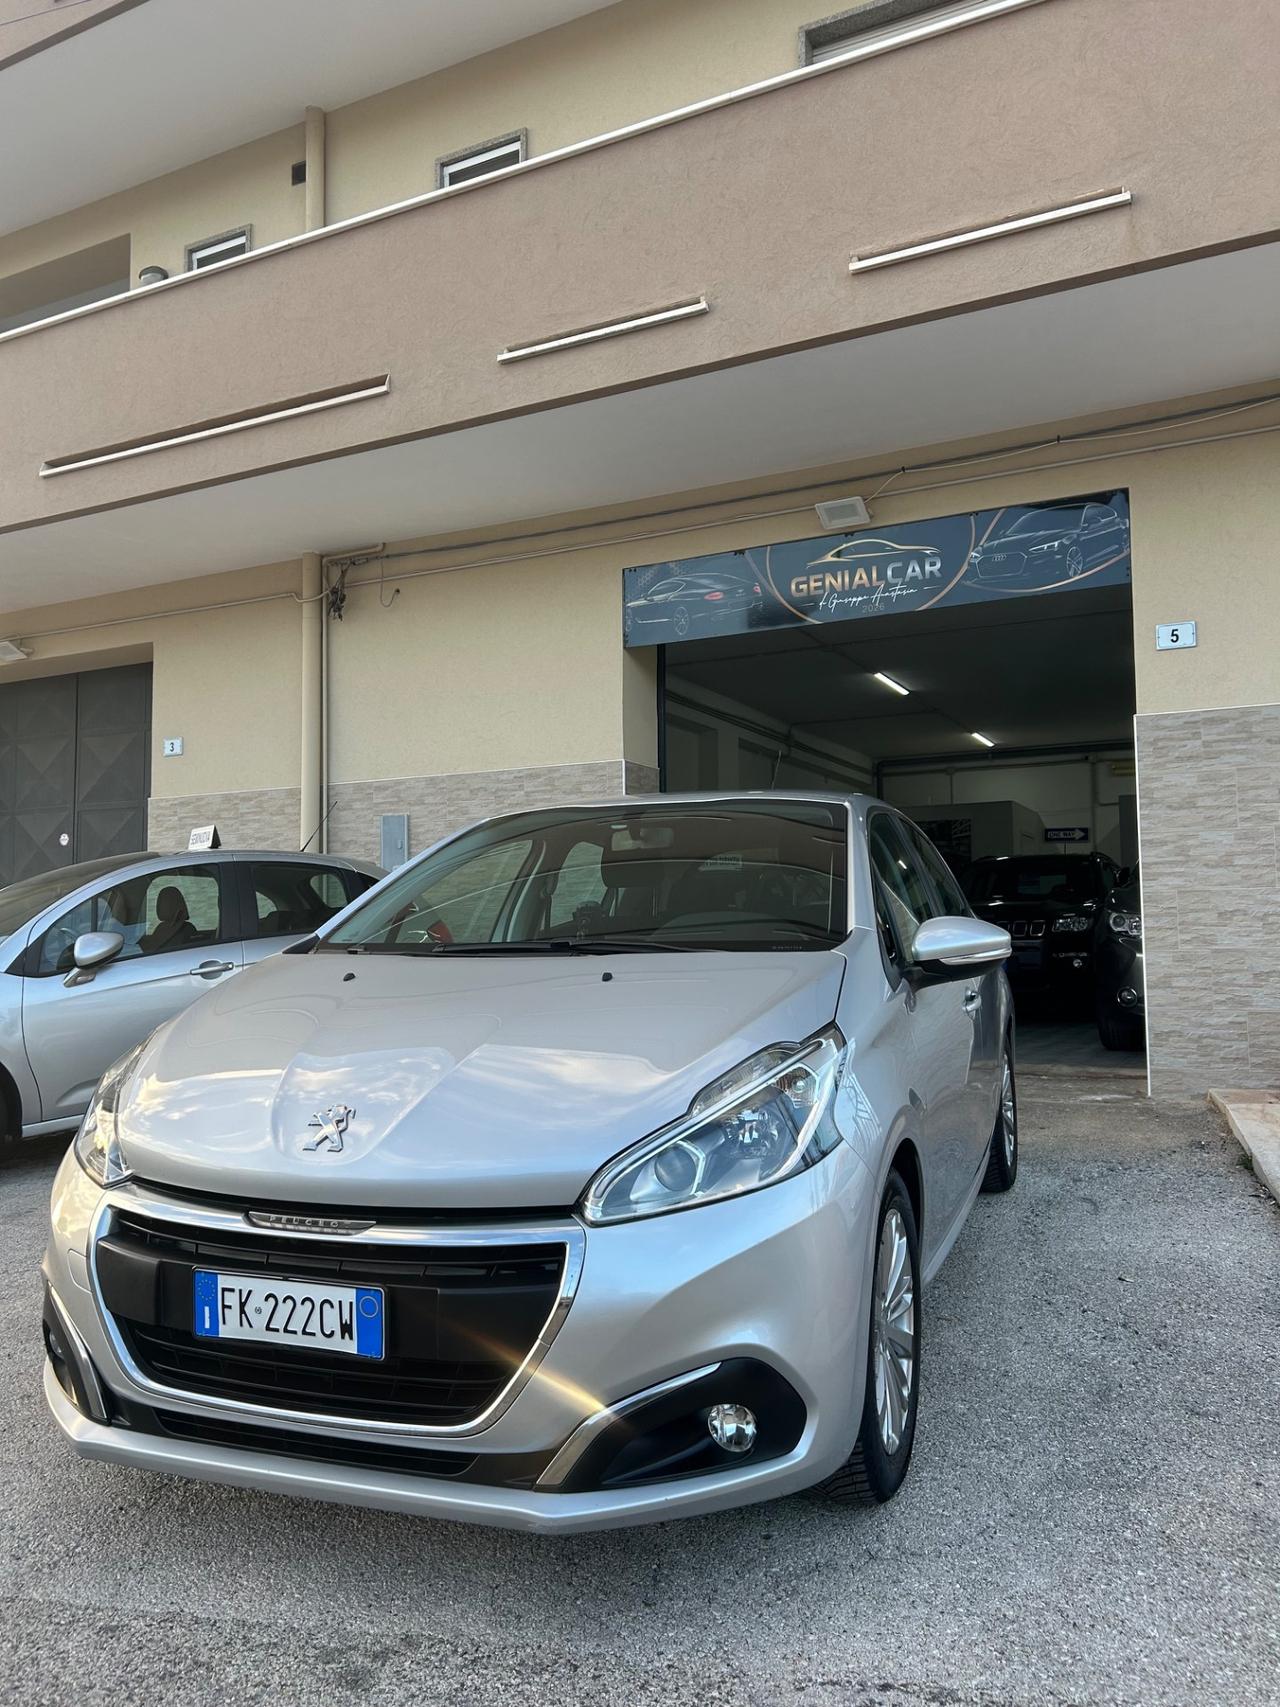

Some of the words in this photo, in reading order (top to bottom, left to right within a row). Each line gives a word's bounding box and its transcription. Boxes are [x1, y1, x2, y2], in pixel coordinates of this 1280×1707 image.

[790, 556, 942, 598] GENIALCAR
[1170, 628, 1179, 643] 5
[169, 742, 175, 752] 3
